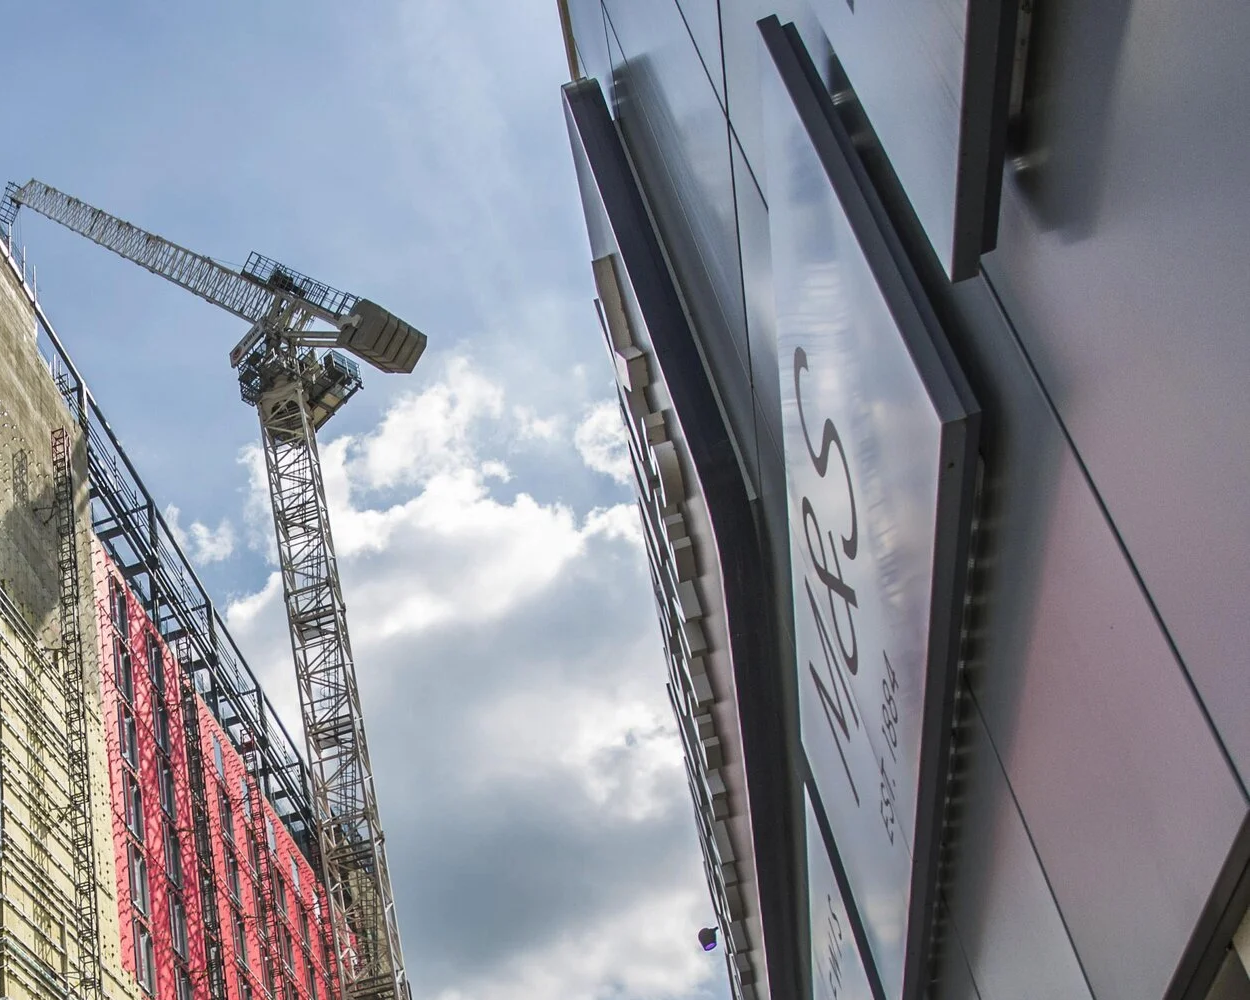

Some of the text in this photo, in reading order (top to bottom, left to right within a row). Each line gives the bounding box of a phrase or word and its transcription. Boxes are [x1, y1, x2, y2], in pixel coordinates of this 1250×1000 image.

[794, 346, 860, 808] M&S
[880, 649, 899, 847] EST. 1884
